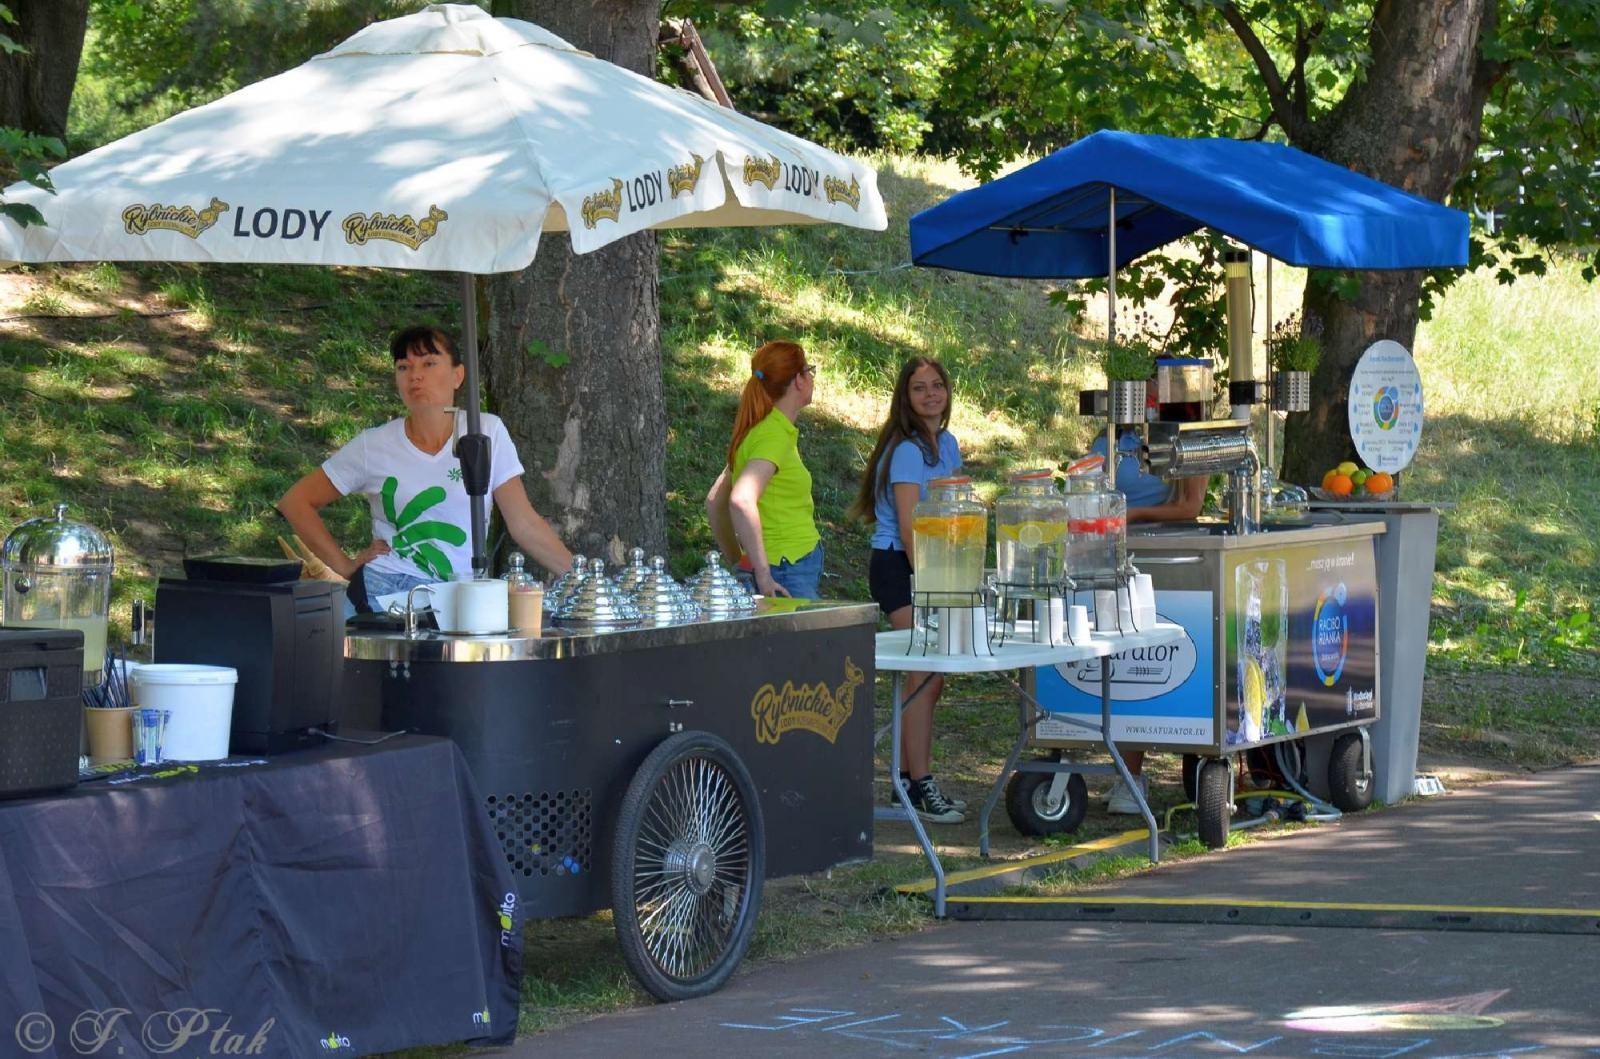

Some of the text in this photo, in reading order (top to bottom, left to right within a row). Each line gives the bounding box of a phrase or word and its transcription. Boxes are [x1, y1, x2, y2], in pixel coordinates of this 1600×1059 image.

[626, 170, 663, 212] LODY
[783, 162, 818, 198] LODY
[124, 205, 198, 232] Rybnickie
[234, 206, 332, 241] LODY
[345, 215, 416, 242] Rybnickie
[755, 686, 832, 739] Rybnickie
[1125, 725, 1206, 737] WWW.SATURATOR.EU
